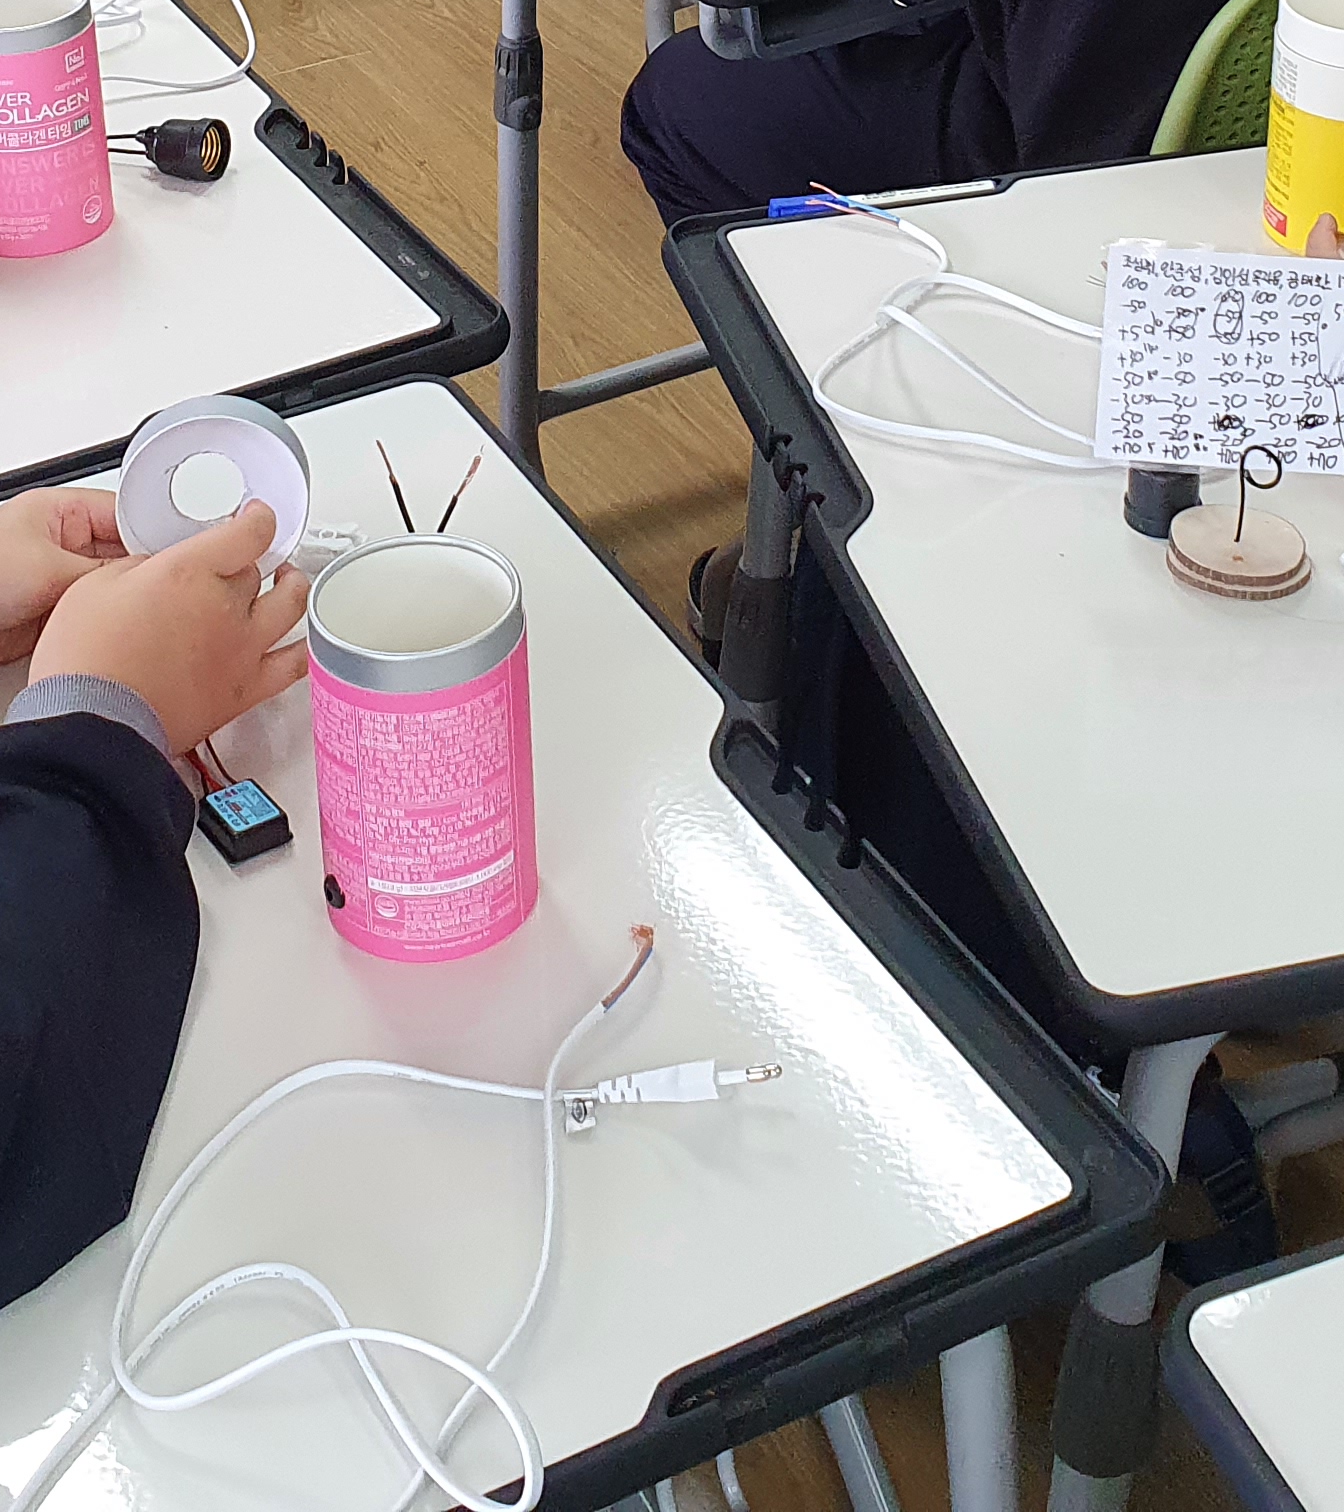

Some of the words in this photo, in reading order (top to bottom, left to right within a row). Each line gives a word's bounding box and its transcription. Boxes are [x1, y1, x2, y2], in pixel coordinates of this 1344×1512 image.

[1164, 284, 1196, 298] 100
[1252, 290, 1277, 304] 100
[1288, 293, 1322, 308] 100
